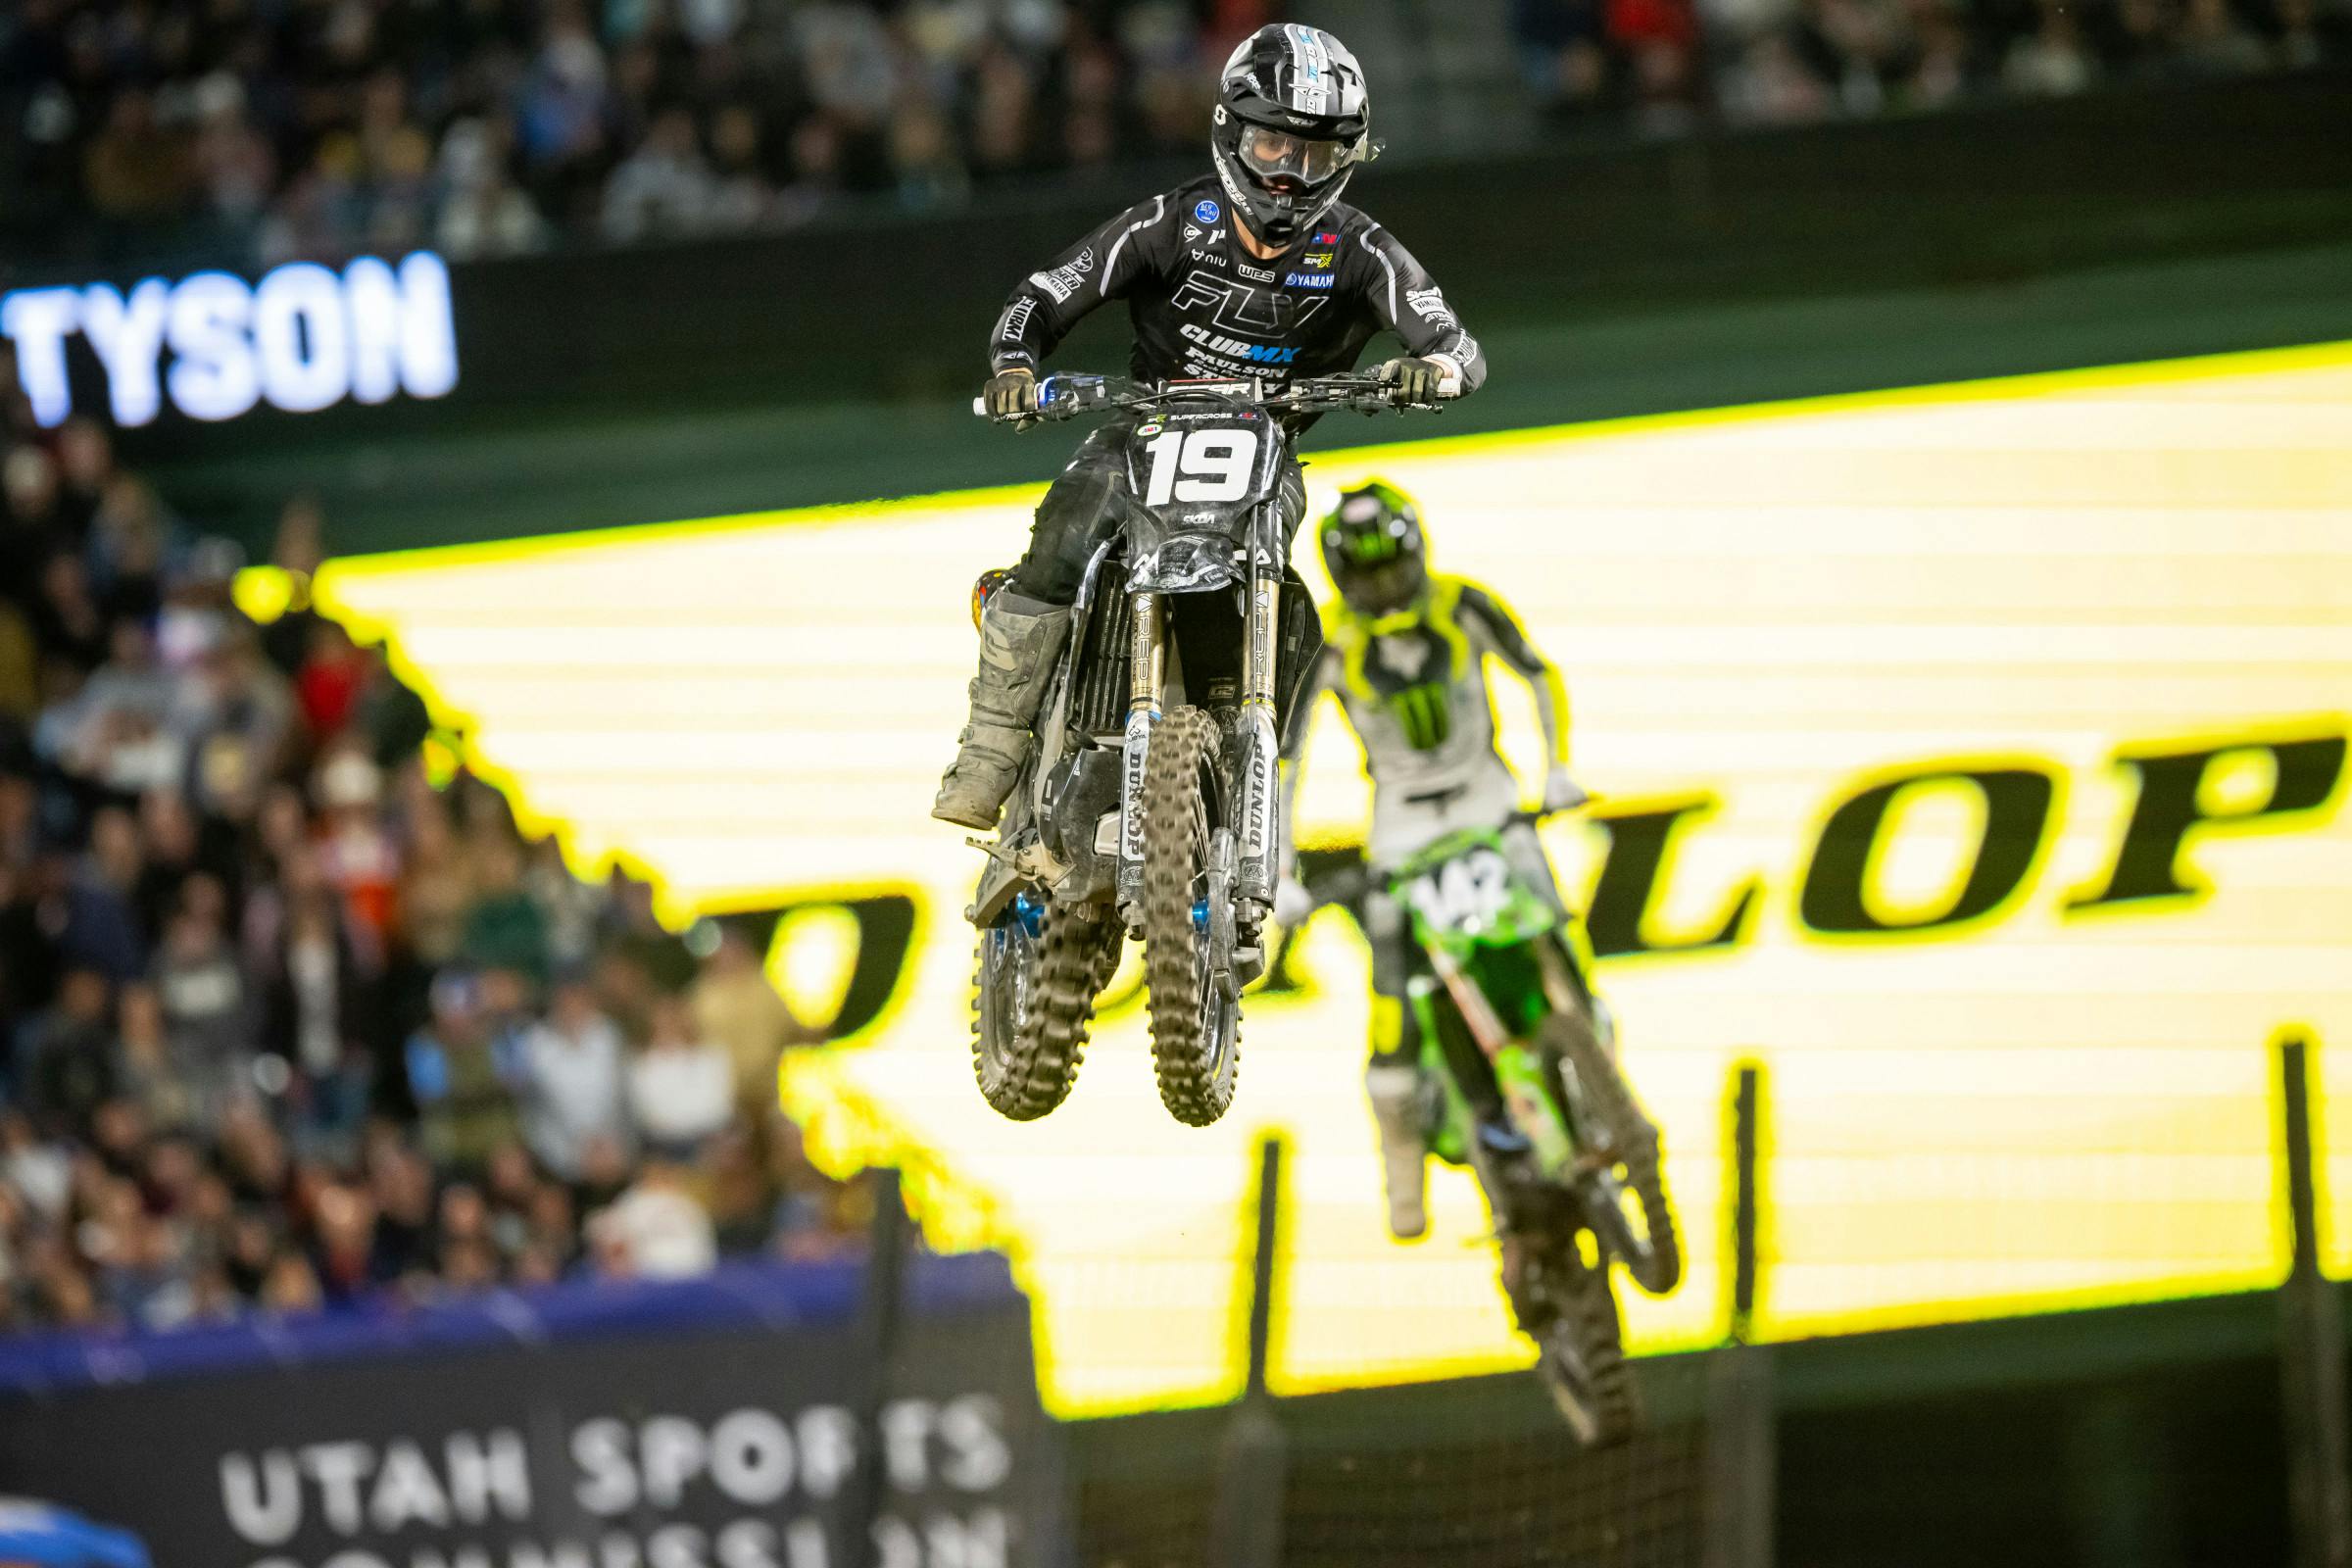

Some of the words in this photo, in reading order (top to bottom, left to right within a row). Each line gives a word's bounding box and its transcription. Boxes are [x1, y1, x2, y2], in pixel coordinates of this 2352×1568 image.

[0, 250, 459, 427] TYSON
[1179, 323, 1301, 363] CLUBMX
[1185, 346, 1289, 377] PAULSON
[1170, 413, 1233, 421] SUPERCROSS
[1146, 429, 1258, 506] 19
[1249, 741, 1266, 851] DUNLOP
[219, 1426, 532, 1545] UTAH
